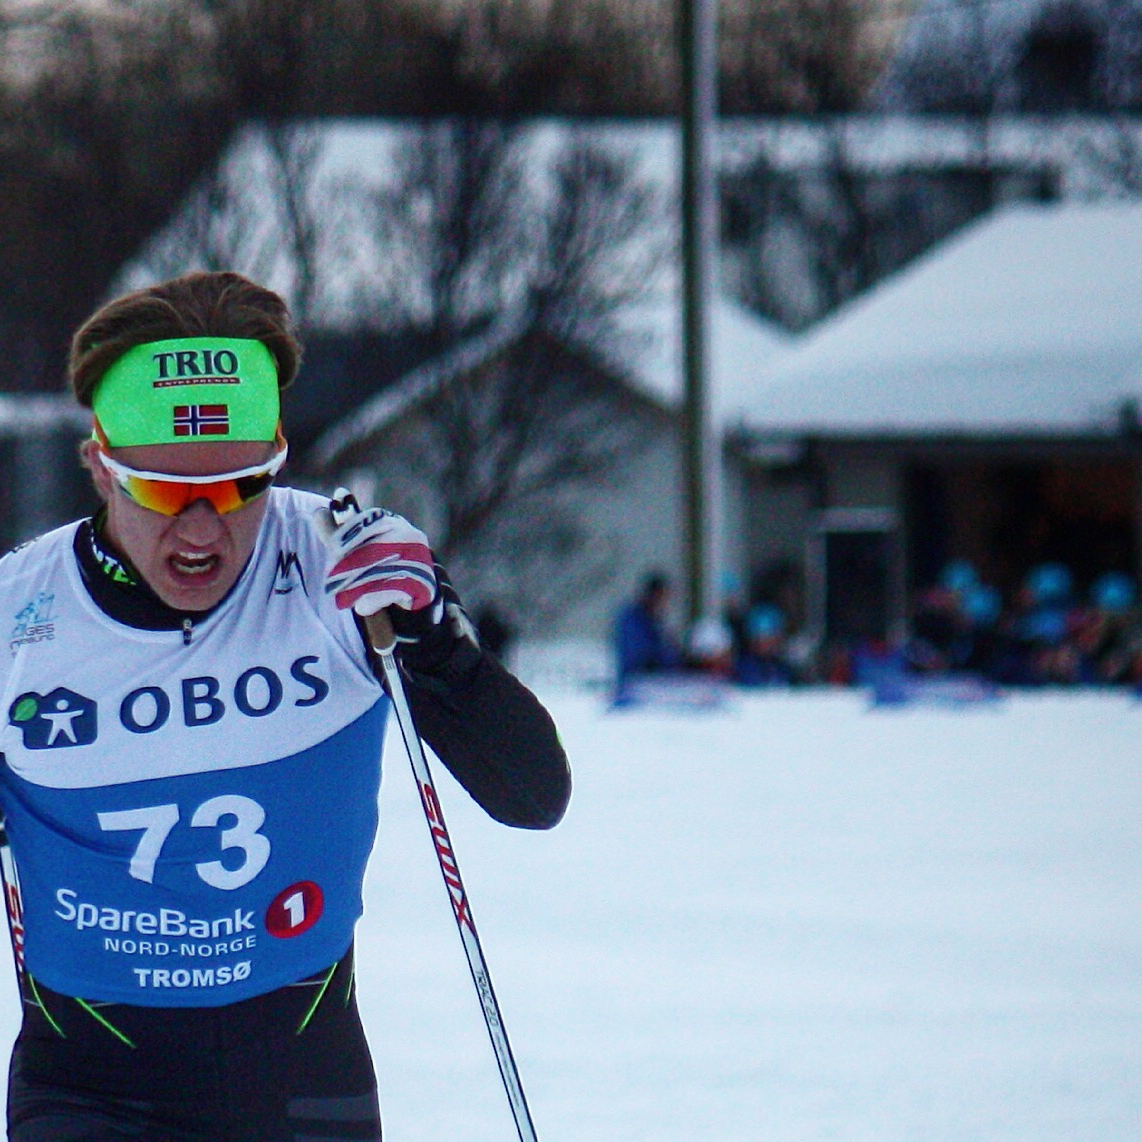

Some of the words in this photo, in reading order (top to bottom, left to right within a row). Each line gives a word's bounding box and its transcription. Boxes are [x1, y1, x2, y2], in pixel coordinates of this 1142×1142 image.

[153, 350, 239, 378] TRIO
[119, 656, 330, 734] OBOS
[97, 795, 271, 891] 73
[55, 888, 255, 939] SpareBank
[104, 935, 257, 957] NORD-NORGE
[134, 960, 251, 988] TROMSØ
